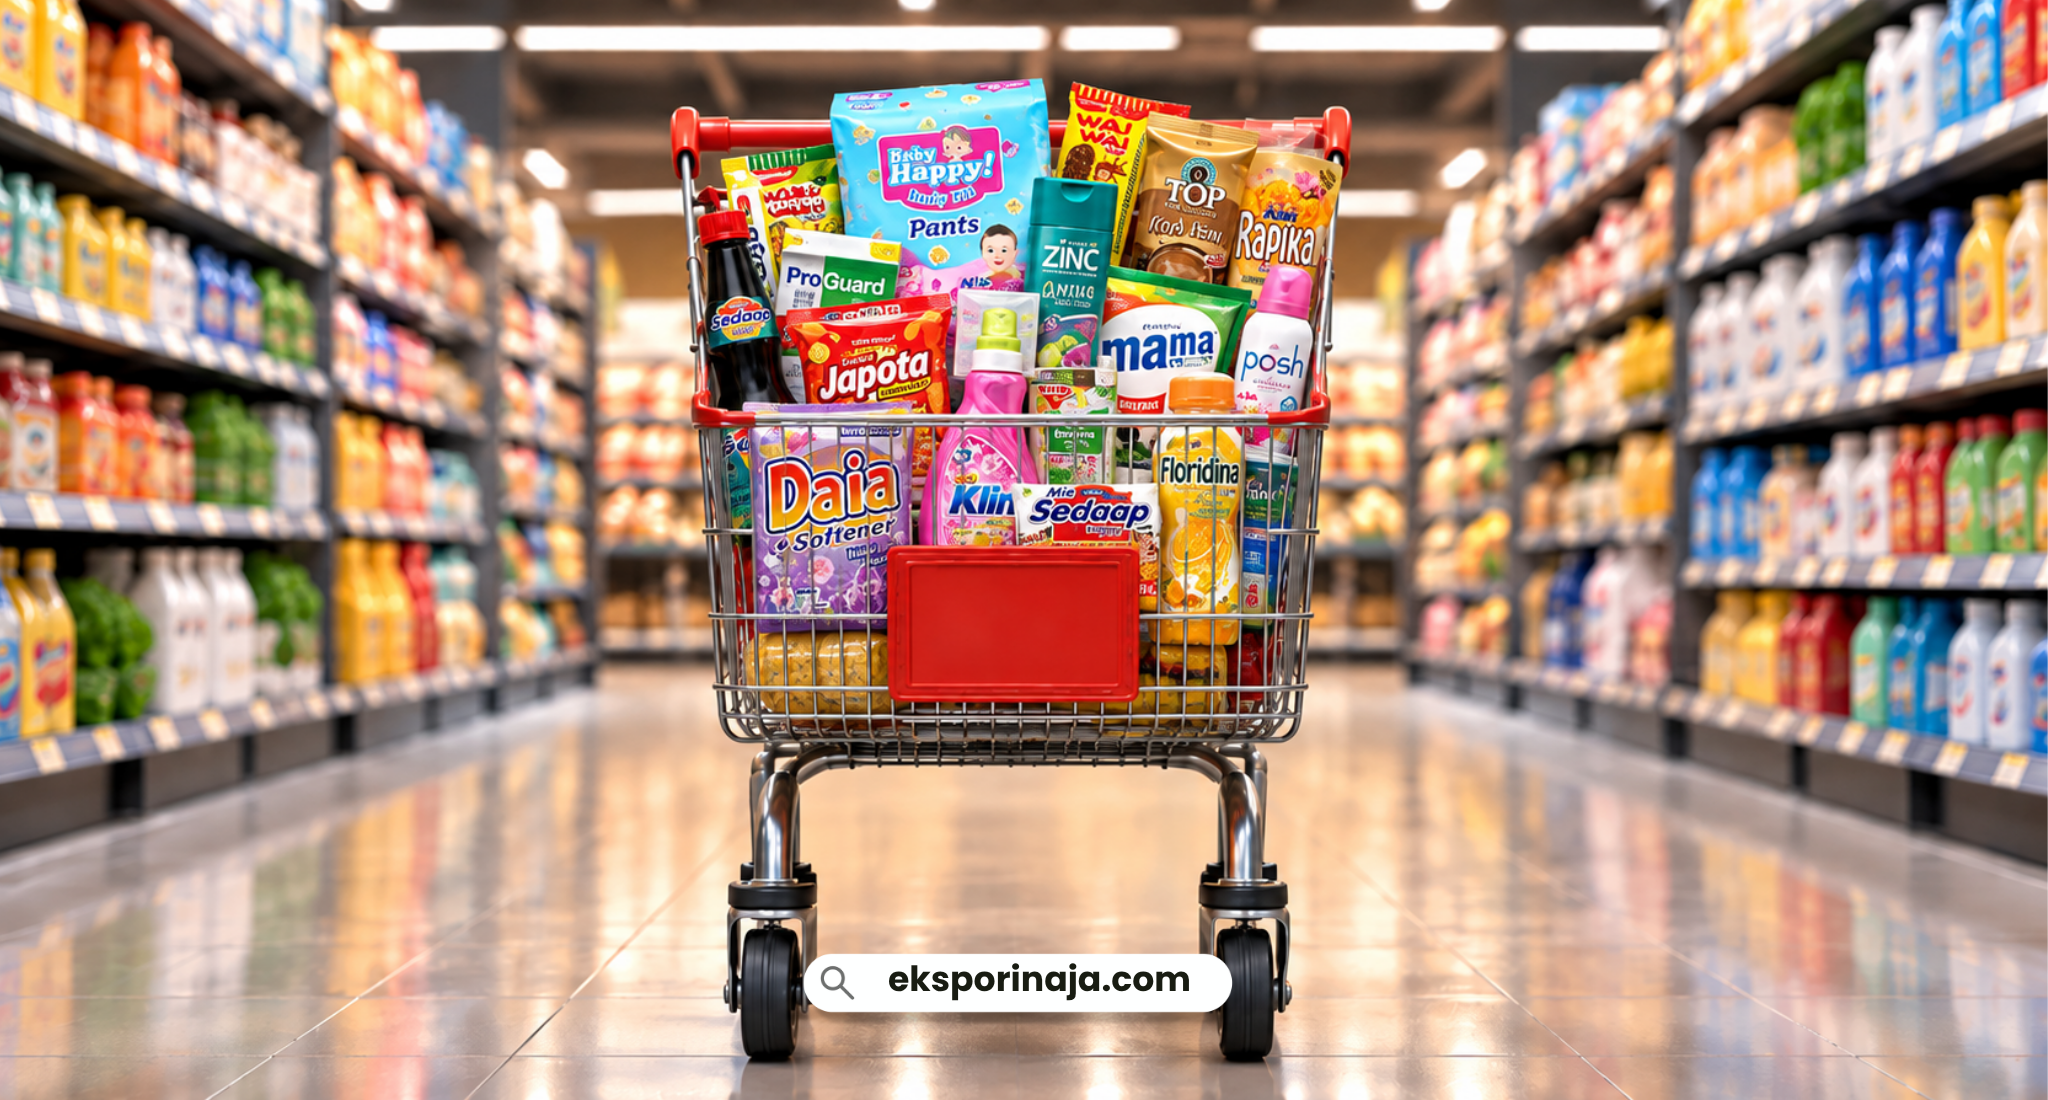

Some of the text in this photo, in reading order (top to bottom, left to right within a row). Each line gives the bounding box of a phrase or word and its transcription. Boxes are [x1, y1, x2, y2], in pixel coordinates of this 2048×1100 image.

[889, 152, 995, 186] Happy!
[1164, 178, 1226, 210] TOP
[908, 217, 979, 239] Pants
[1235, 210, 1316, 266] Rapika
[1041, 245, 1099, 271] ZINC
[1102, 330, 1214, 372] mama
[1240, 344, 1304, 382] posh
[820, 350, 929, 400] Japota
[1160, 456, 1240, 484] Floridina
[765, 449, 900, 534] Daia
[948, 484, 1016, 515] Klin
[1046, 486, 1076, 498] Mie
[1030, 498, 1151, 528] Sedaap
